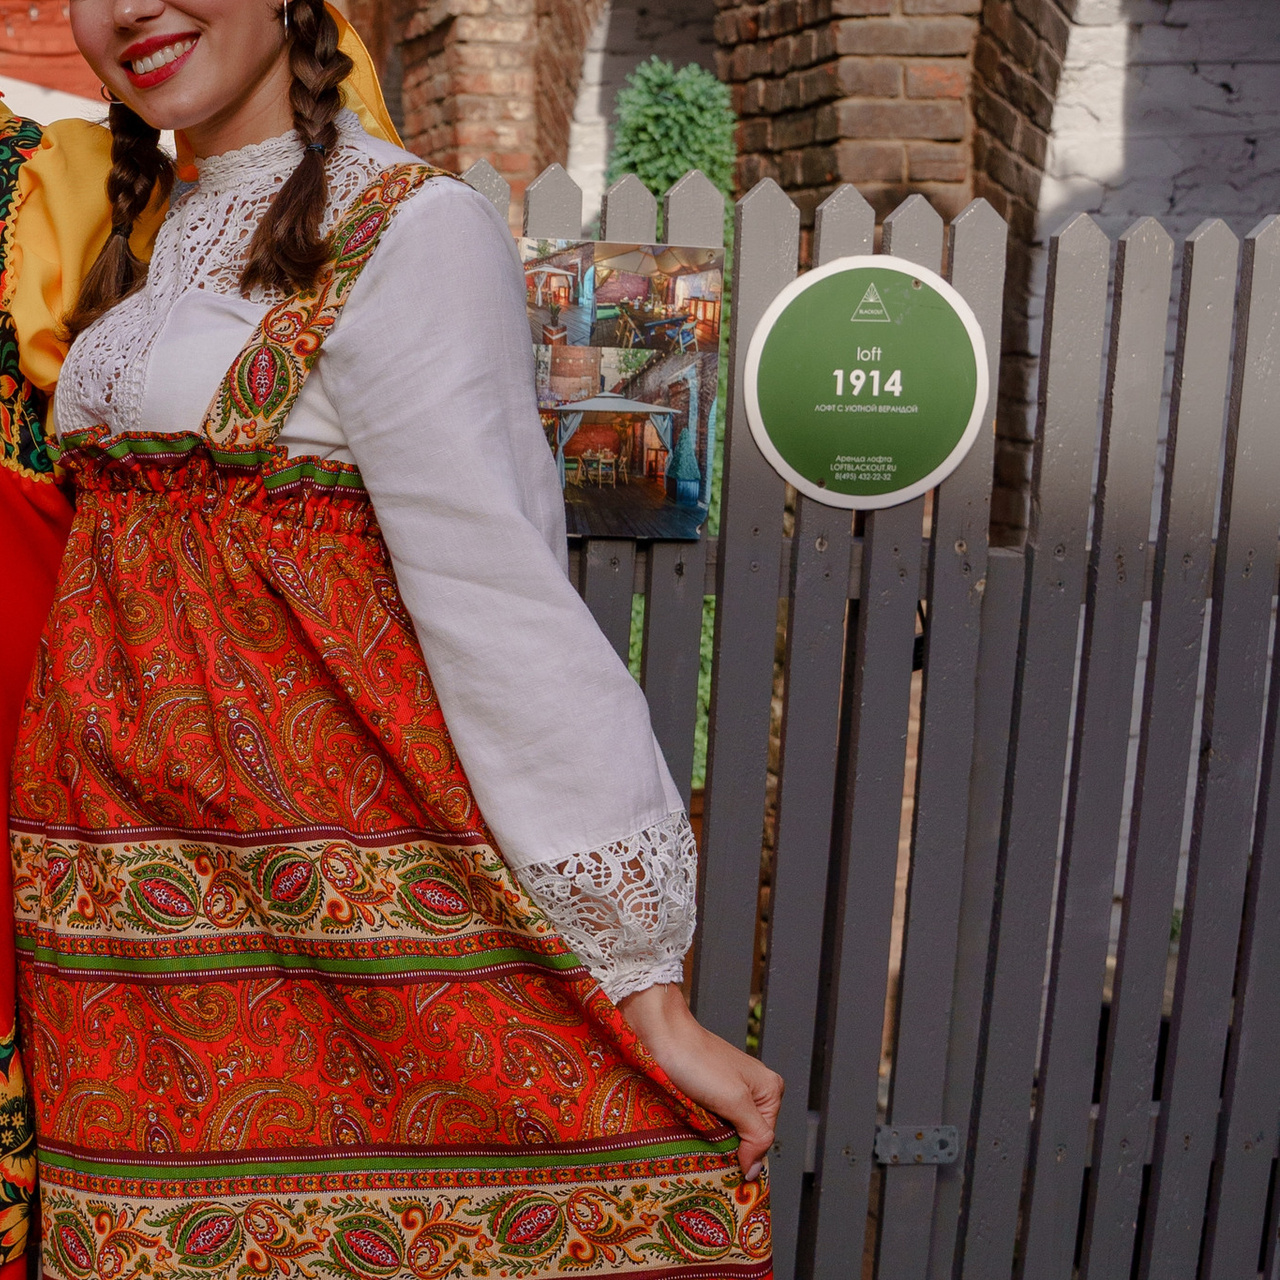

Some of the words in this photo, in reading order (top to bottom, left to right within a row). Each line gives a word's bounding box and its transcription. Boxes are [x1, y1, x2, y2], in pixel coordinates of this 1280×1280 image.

[856, 346, 882, 361] loft
[832, 369, 903, 397] 1914
[815, 404, 836, 412] ЛОФТ
[837, 404, 843, 412] С
[845, 403, 877, 413] УЮТНОЙ
[878, 404, 918, 413] ВЕРАНДОЙ
[835, 455, 866, 463] Аренда
[867, 455, 893, 463] лофта
[830, 463, 897, 472] LOFTBLACKOUT.RU
